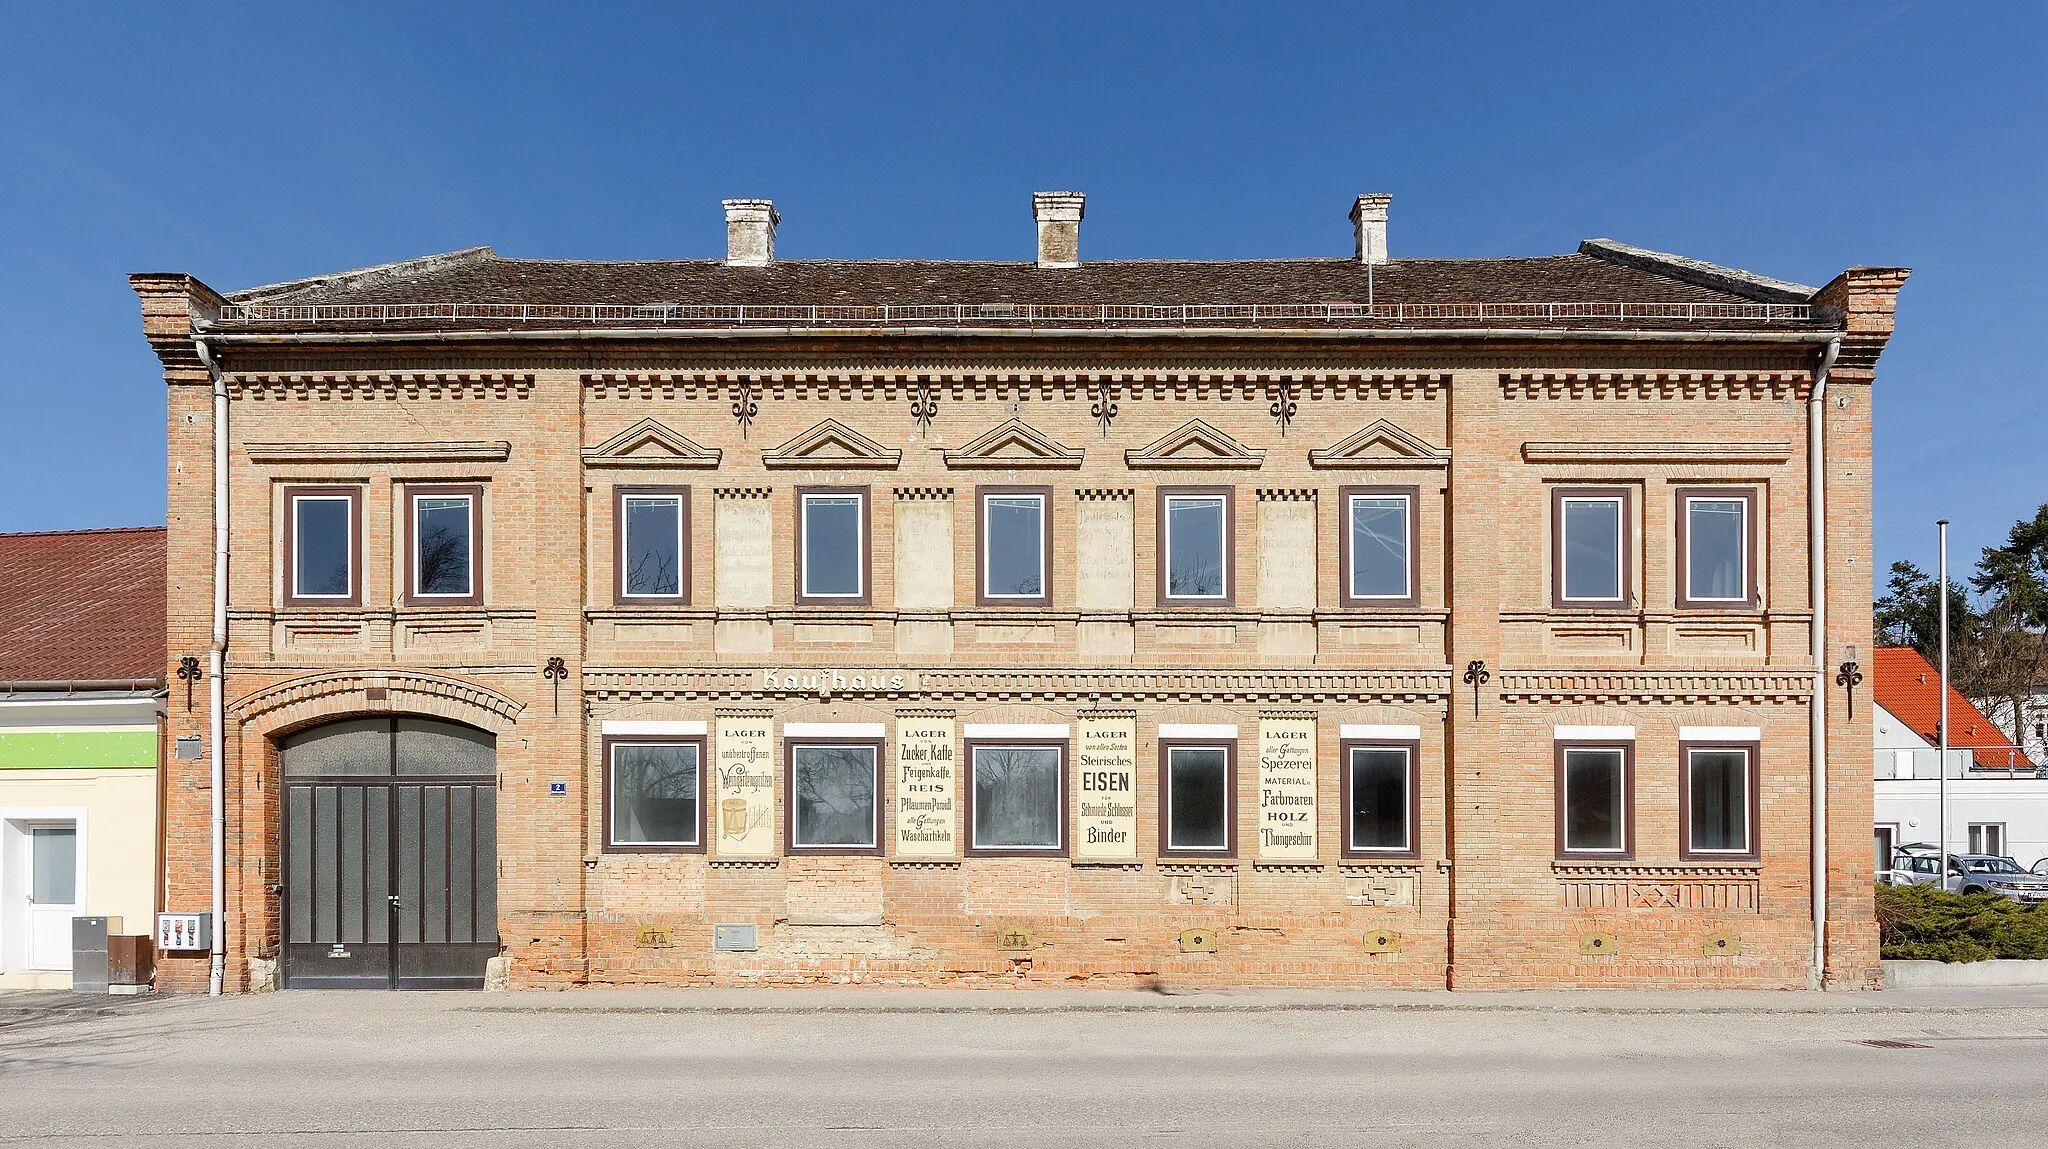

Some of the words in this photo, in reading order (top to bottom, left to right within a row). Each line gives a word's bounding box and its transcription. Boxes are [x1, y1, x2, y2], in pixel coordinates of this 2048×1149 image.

[762, 668, 904, 695] Kaufhaus
[725, 730, 766, 738] LAGER
[905, 730, 946, 738] LAGER
[1085, 731, 1127, 739] LAGER
[1266, 731, 1307, 739] LAGER
[1080, 754, 1132, 767] Steirisches
[1261, 756, 1312, 773] Spezerei
[1083, 771, 1129, 791] EISEN
[1264, 777, 1307, 785] MATERIAL
[909, 784, 944, 792] REIS
[1261, 789, 1314, 808] Farbwaren
[1267, 812, 1308, 822] HOLZ
[900, 829, 951, 842] Waschartikeln
[1086, 826, 1127, 844] Binder
